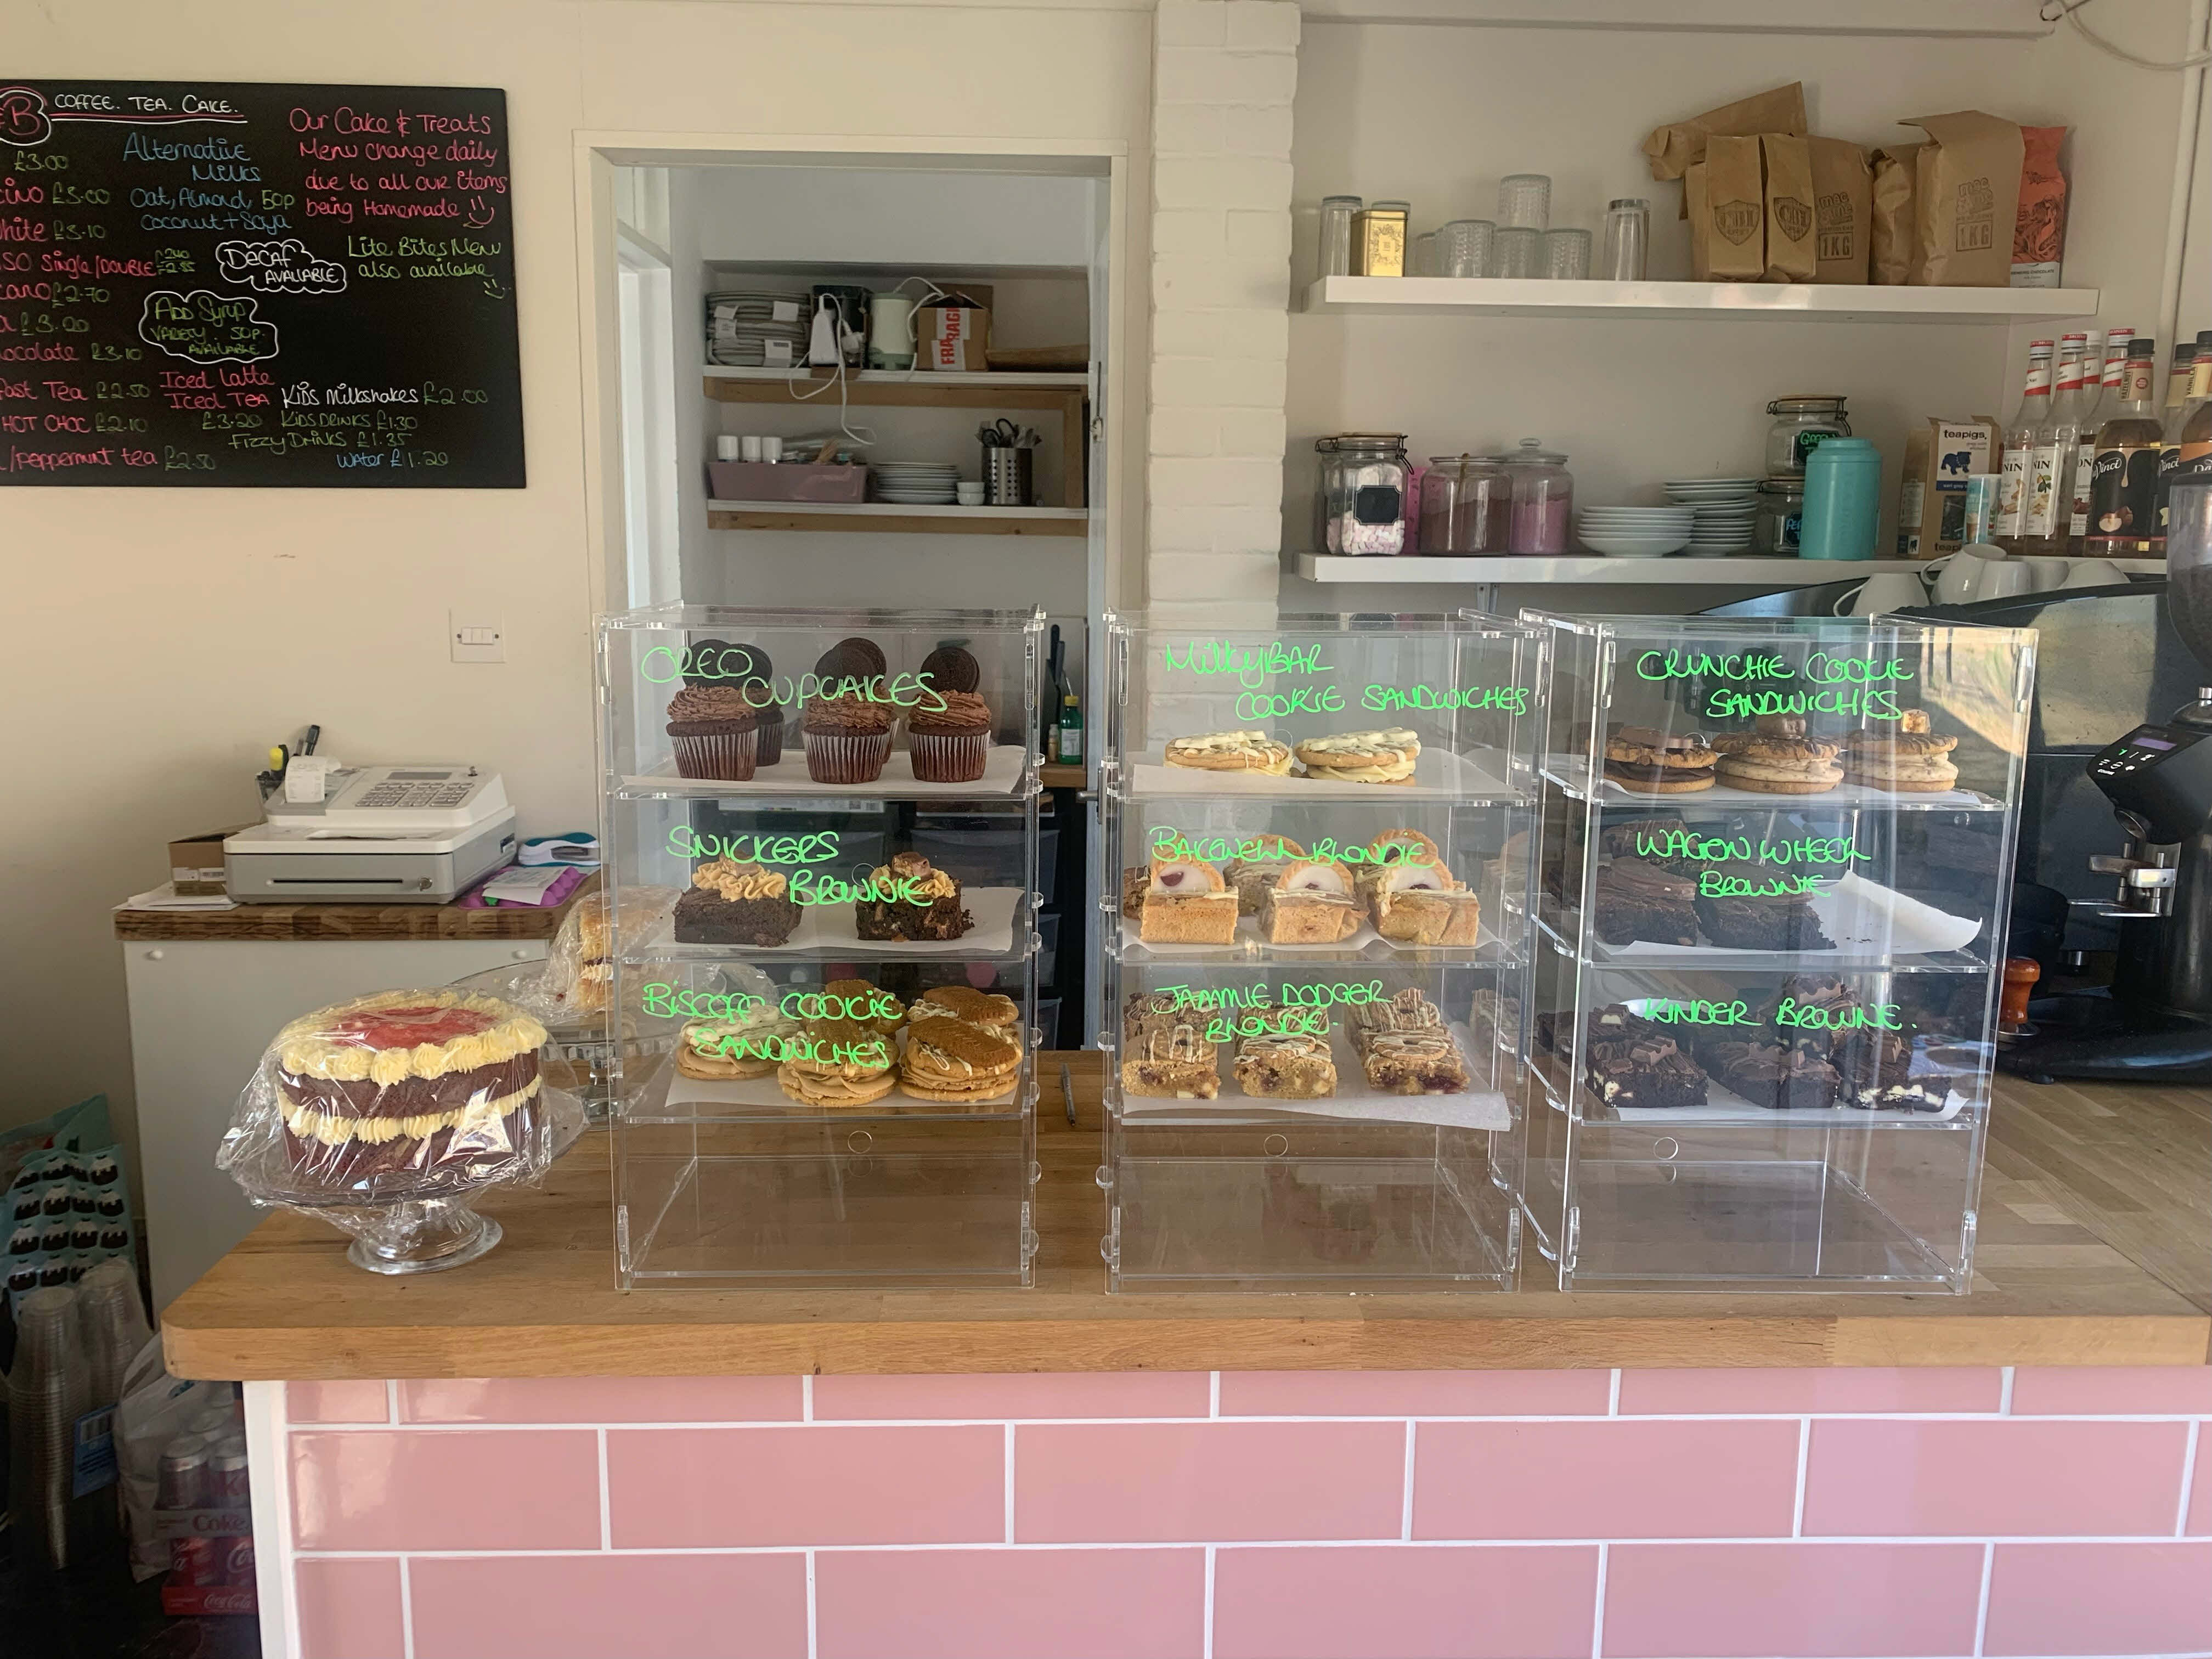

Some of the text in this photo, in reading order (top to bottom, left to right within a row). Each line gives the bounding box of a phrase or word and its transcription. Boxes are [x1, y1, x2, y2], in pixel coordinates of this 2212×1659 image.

[290, 108, 330, 132] Our
[334, 106, 391, 134] Cake
[415, 112, 492, 134] Treats
[300, 138, 359, 161] Menu
[445, 139, 498, 167] daily
[305, 168, 345, 191] due
[350, 173, 369, 190] to
[379, 173, 411, 190] all
[456, 169, 508, 194] items
[306, 196, 461, 223] being Homemade
[348, 235, 500, 257] Lite Bites Menu
[358, 258, 494, 279] also available
[42, 380, 88, 402] Tea
[158, 370, 217, 389] Iced
[163, 392, 227, 410] Iced
[1944, 429, 1987, 439] teapigs.
[121, 448, 158, 467] tea
[641, 646, 752, 682] OREO
[1637, 650, 1915, 684] CRUNCHIE COOKIE
[742, 672, 949, 712] CUPCAKES
[1235, 684, 1530, 721] COOKIE SANDWICHES
[1706, 688, 1903, 720] SANDWICHES
[665, 825, 840, 864] SNICKERS
[1637, 829, 1872, 865] WAGON WHEEL
[789, 868, 934, 906] BROWNIE
[1699, 870, 1832, 898] BROWNIE
[1151, 979, 1393, 1014] JAMMIE DODGER
[1644, 997, 1763, 1026] KINDER
